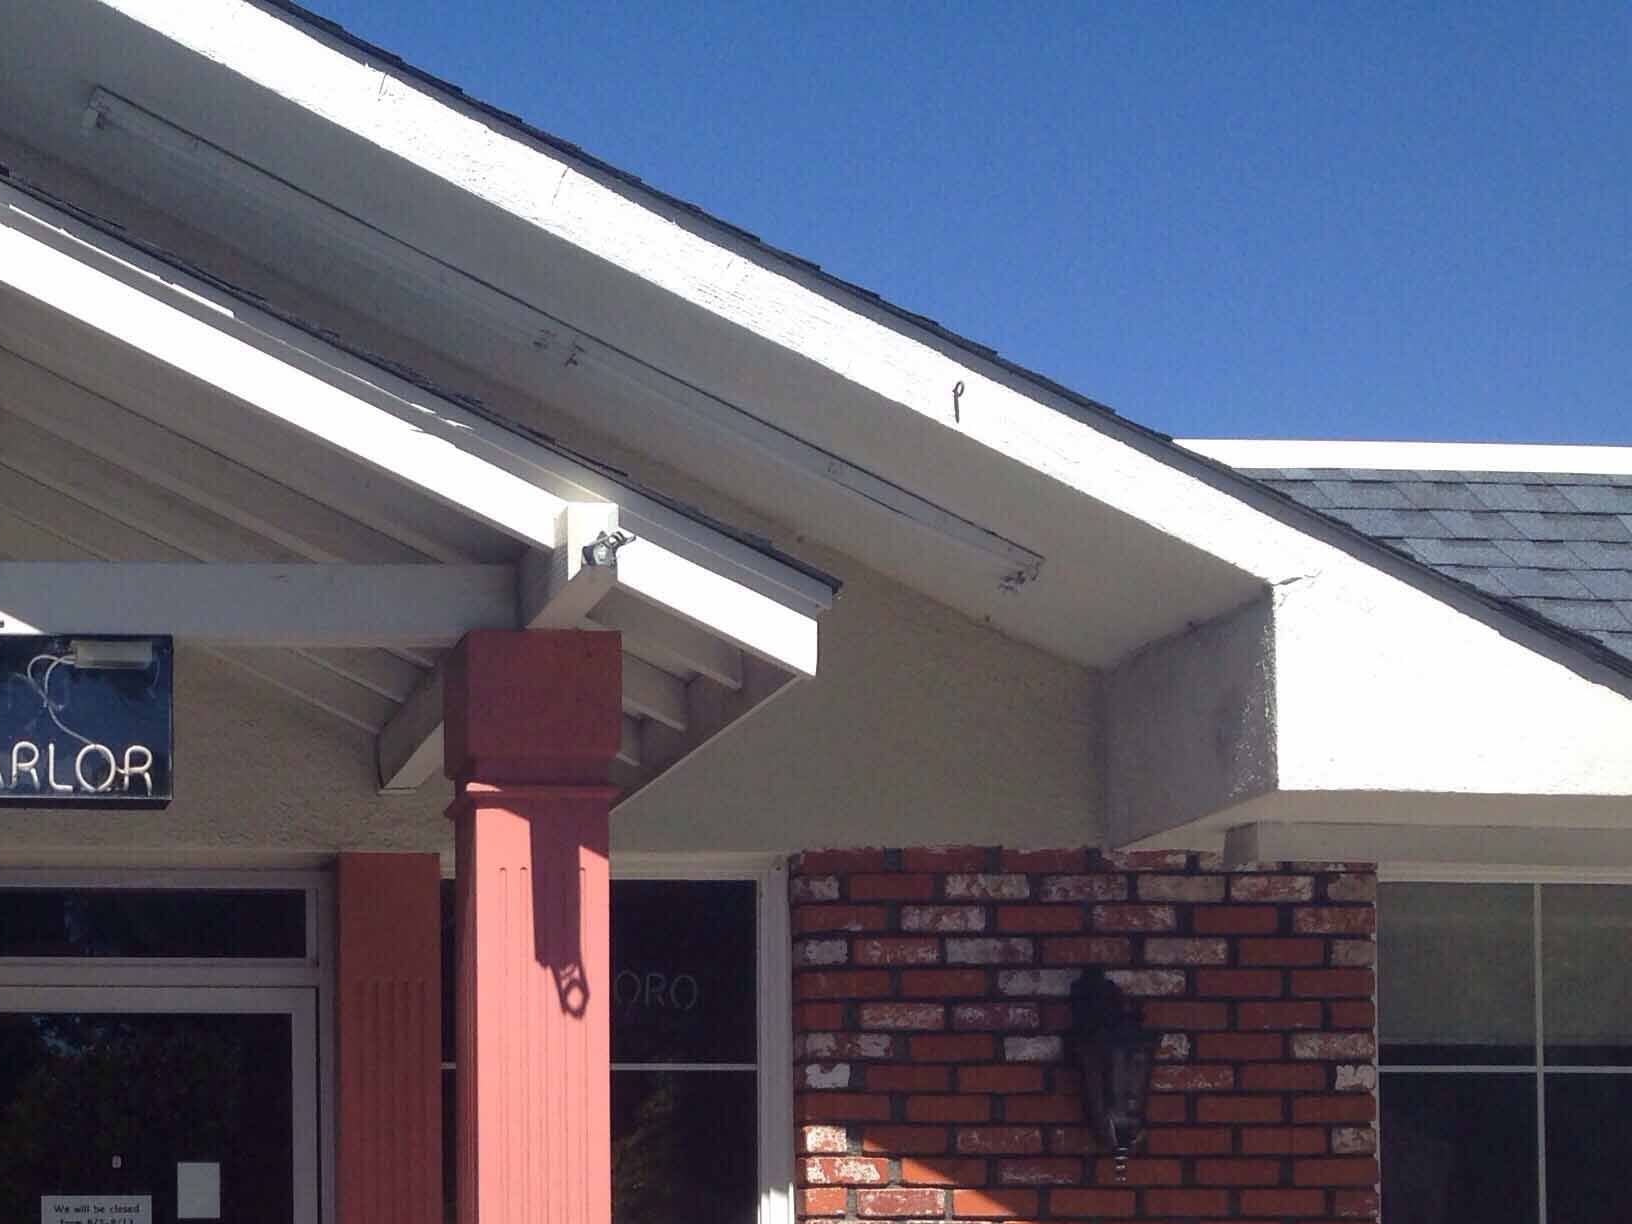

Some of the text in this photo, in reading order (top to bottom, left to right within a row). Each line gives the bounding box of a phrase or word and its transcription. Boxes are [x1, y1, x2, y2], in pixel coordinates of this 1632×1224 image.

[54, 1203, 140, 1213] We will be closed
